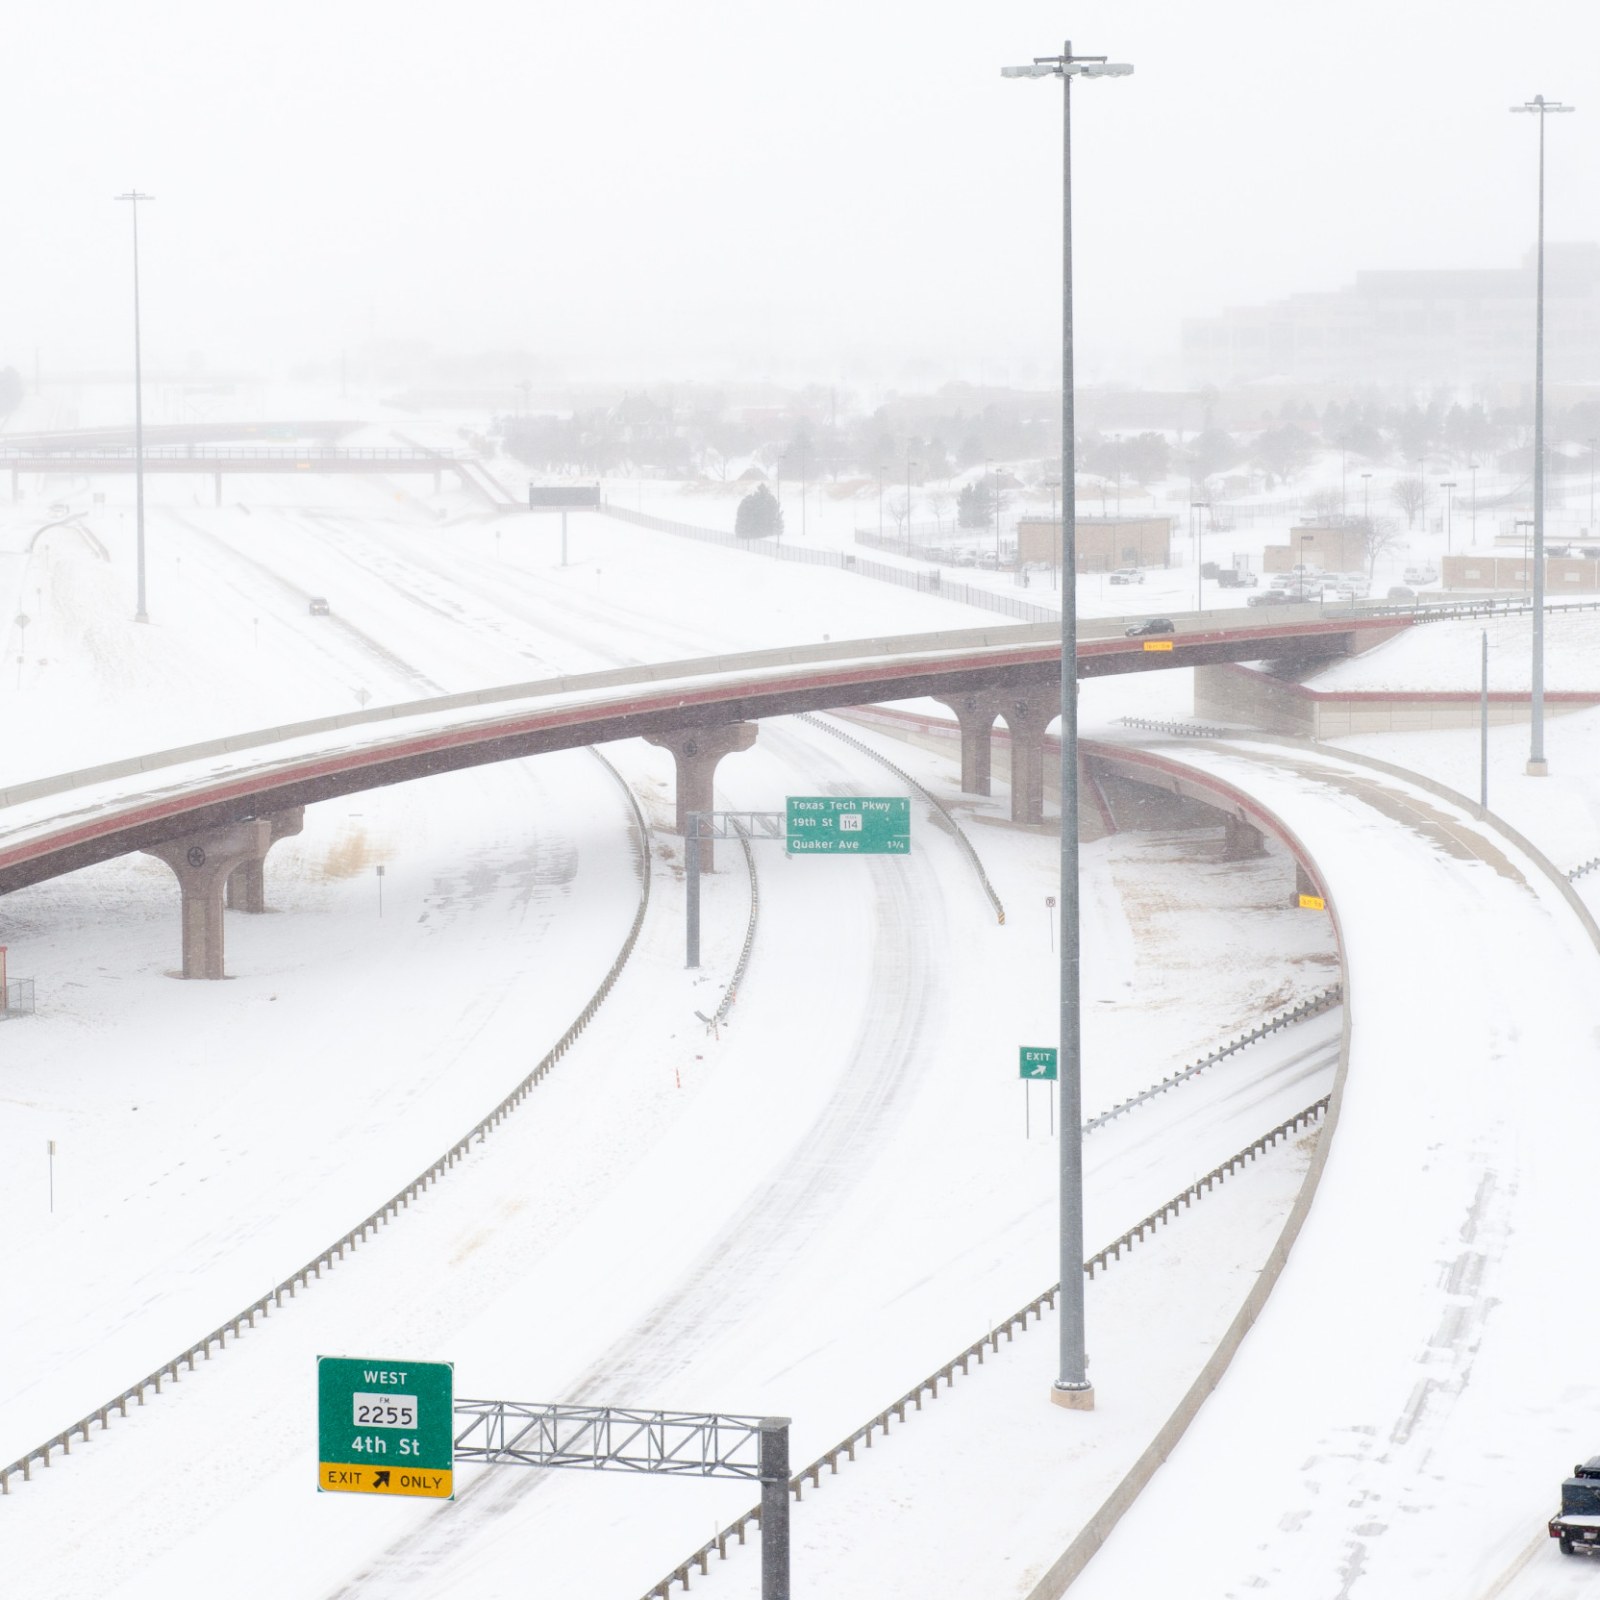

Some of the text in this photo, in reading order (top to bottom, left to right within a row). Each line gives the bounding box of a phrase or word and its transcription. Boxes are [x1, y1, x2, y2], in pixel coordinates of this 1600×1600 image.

[792, 801, 905, 812] Texas Tech Pkwy 1
[793, 818, 833, 827] 19th St
[843, 820, 858, 829] 114
[792, 840, 833, 850] Quaker
[838, 840, 859, 849] Ave
[1026, 1052, 1051, 1061] EXIT
[363, 1370, 407, 1385] WEST
[358, 1405, 412, 1425] 2255
[351, 1436, 420, 1456] 4th St
[328, 1471, 443, 1489] EXIT ONLY
